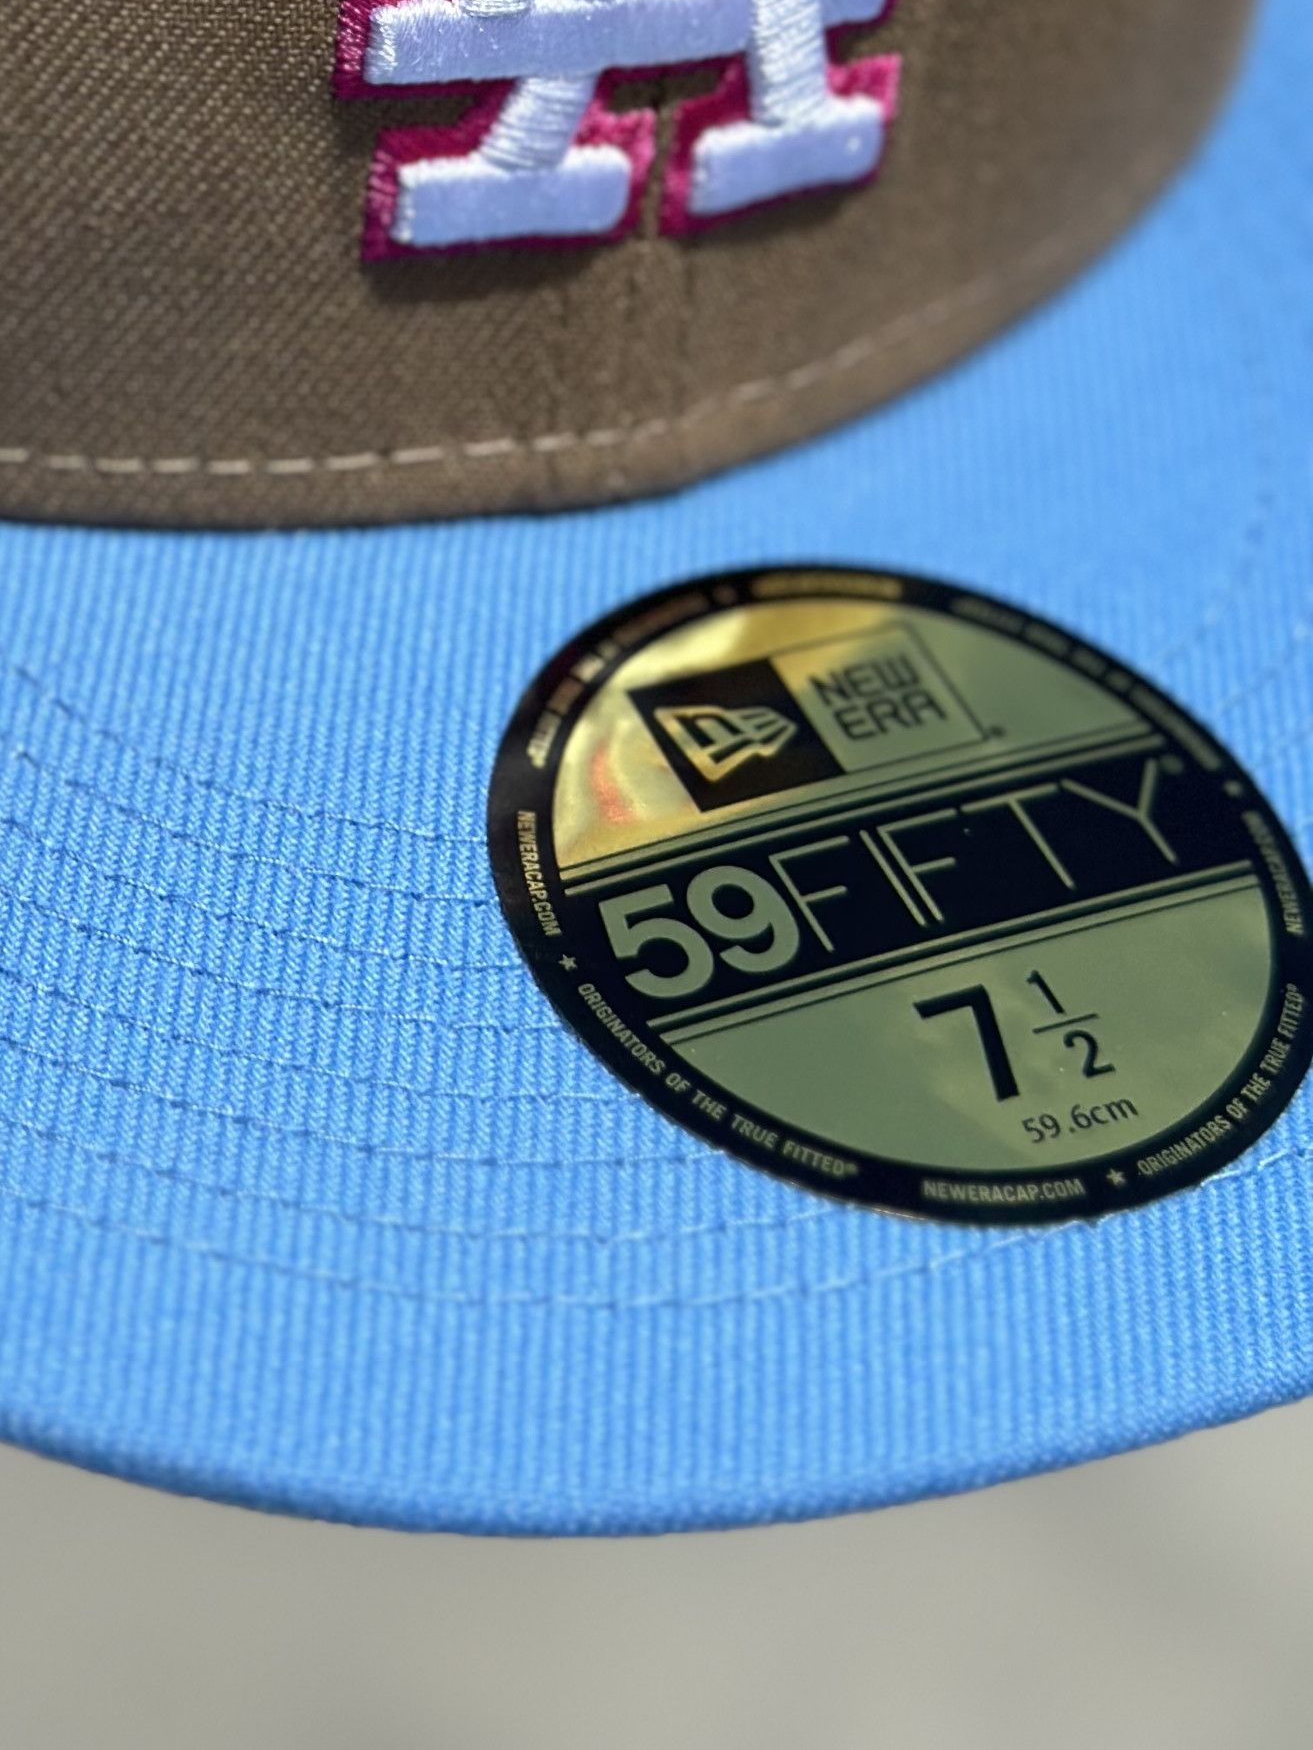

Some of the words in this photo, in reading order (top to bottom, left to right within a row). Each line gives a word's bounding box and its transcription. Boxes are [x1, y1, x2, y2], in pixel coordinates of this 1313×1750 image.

[808, 654, 921, 707] NEW
[834, 689, 948, 741] ERA
[516, 809, 563, 937] NEWERACAP.COM
[577, 982, 666, 1076] ORIGINATORS
[665, 1072, 691, 1093] OF
[691, 1089, 728, 1121] THE
[730, 1113, 779, 1149] TRUE
[912, 983, 1020, 1102] 7
[1021, 1098, 1139, 1144] 59.6cm
[1137, 1114, 1232, 1176] ORIGINATORS
[1225, 1097, 1248, 1120] OF
[1240, 1072, 1271, 1102] THE
[1259, 1037, 1291, 1076] TRUE
[921, 1177, 1086, 1203] NEWERACAP.COM
